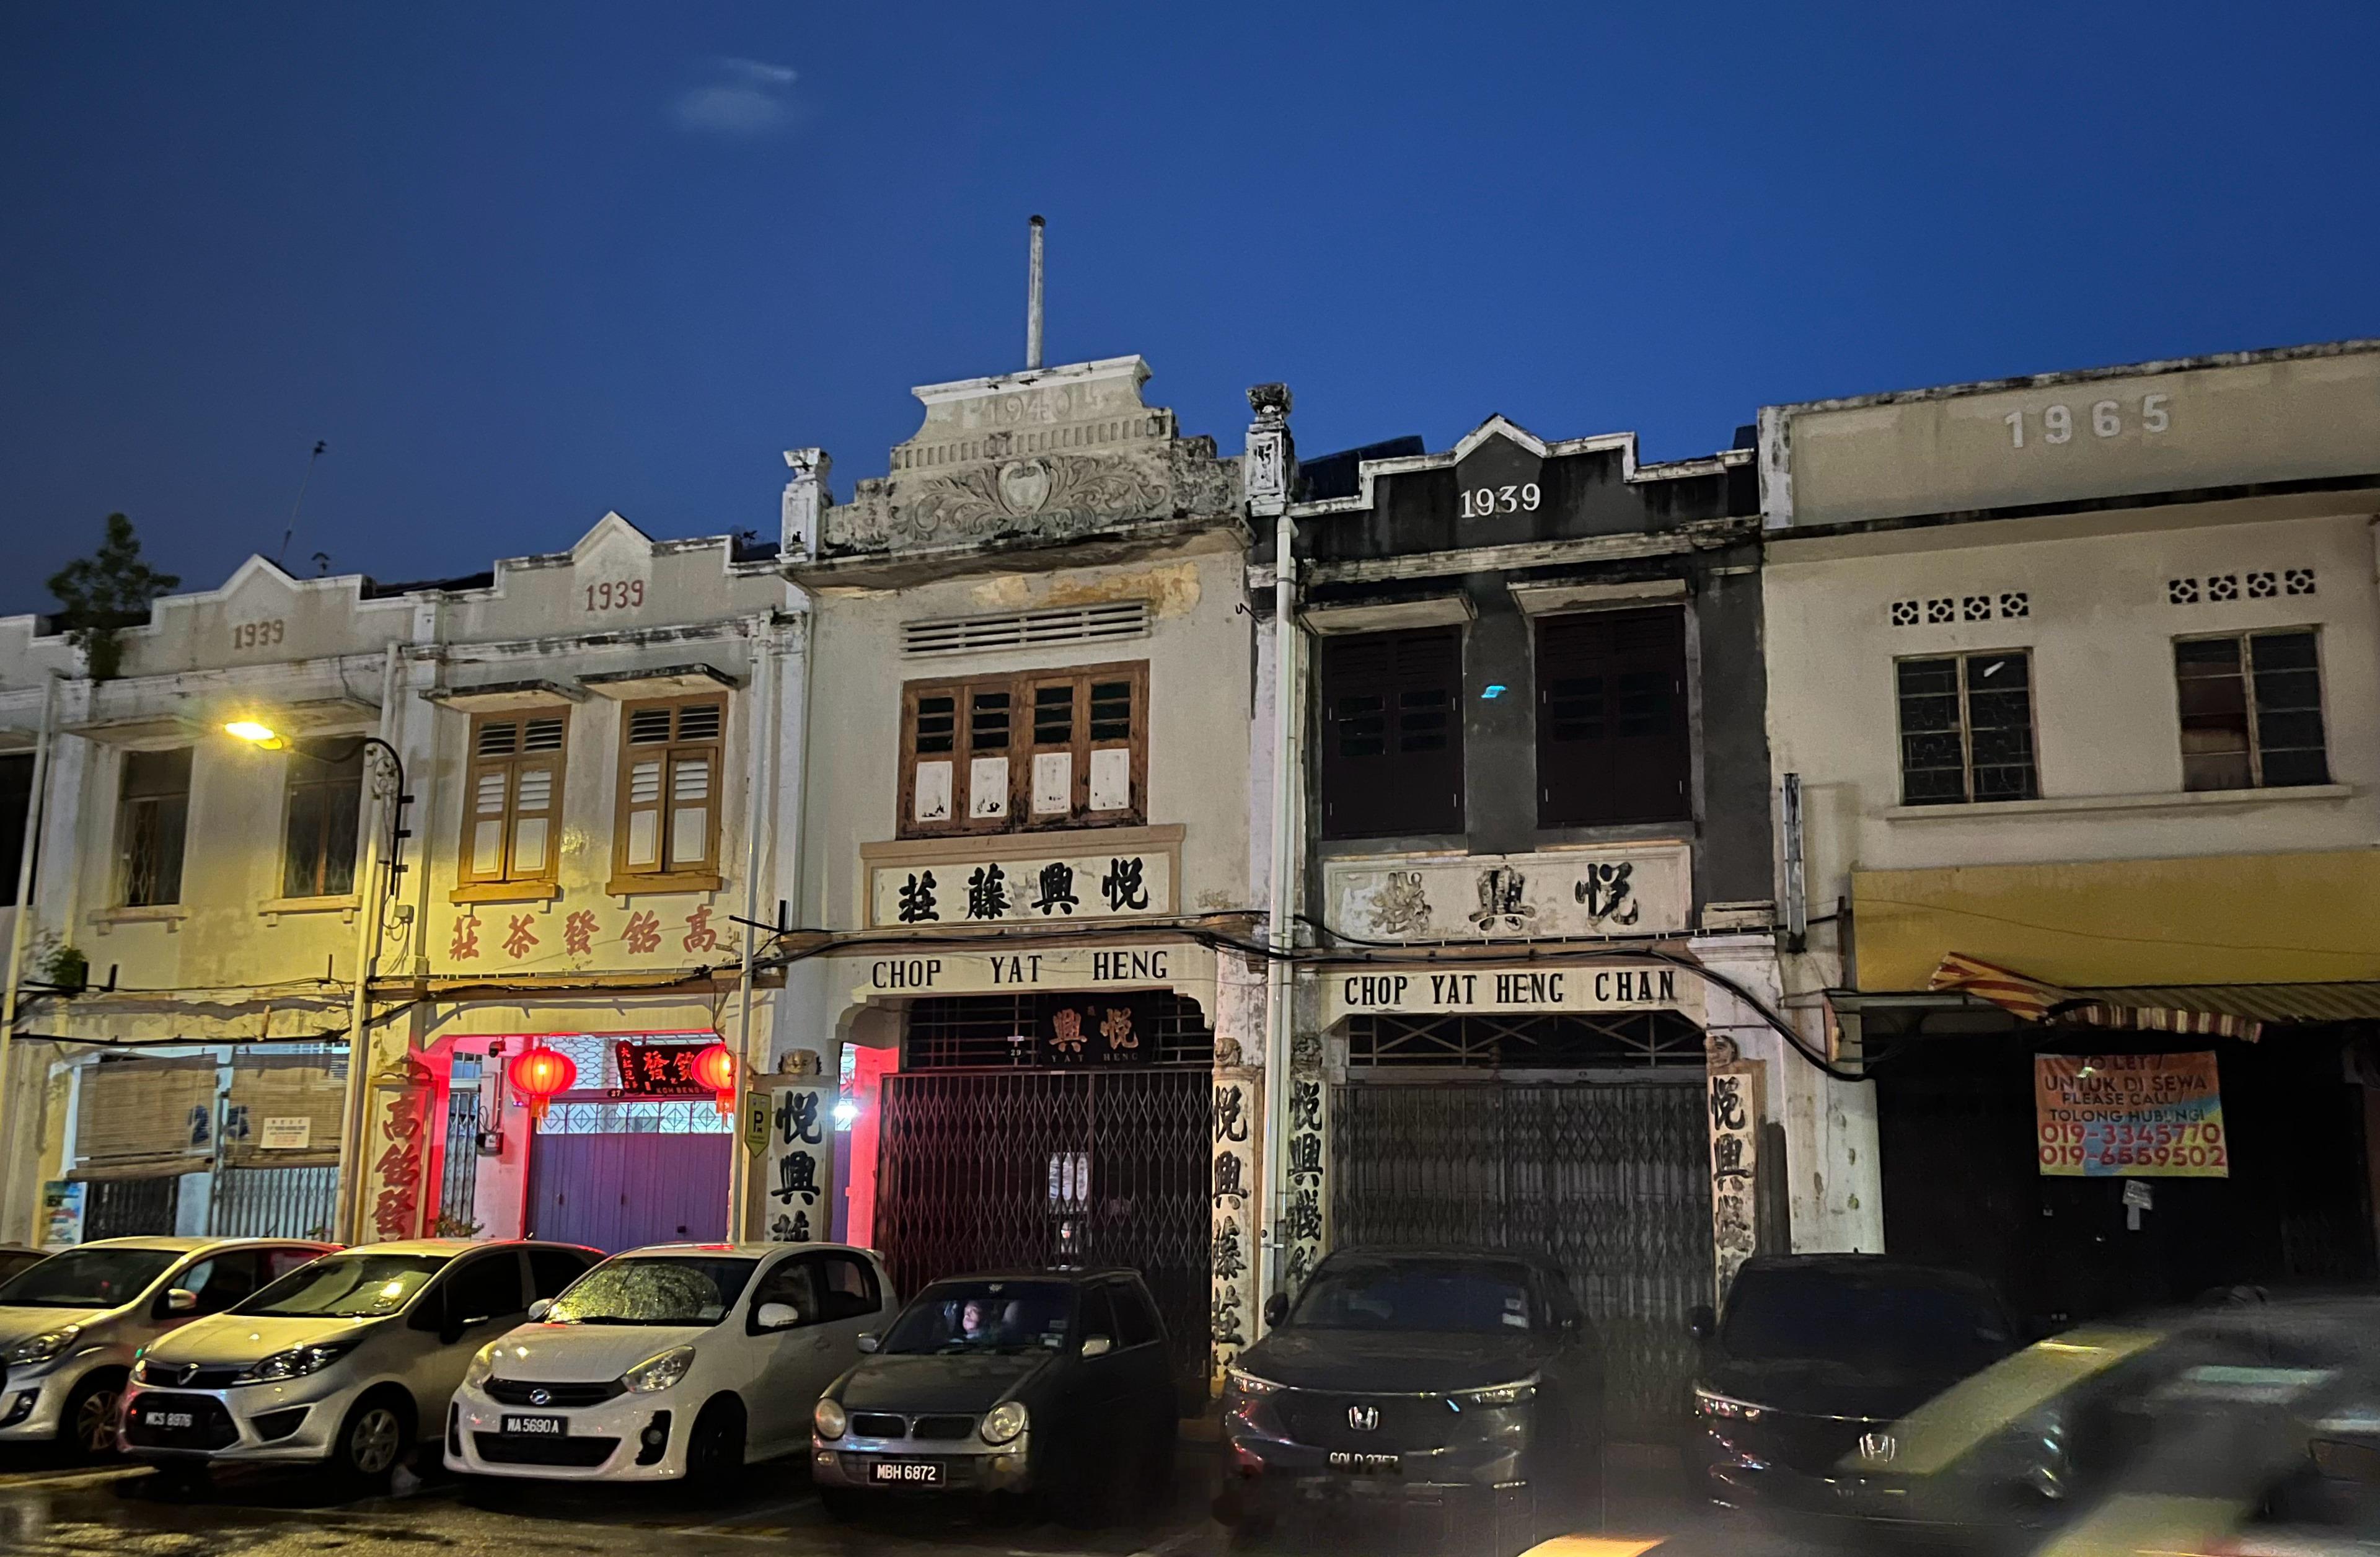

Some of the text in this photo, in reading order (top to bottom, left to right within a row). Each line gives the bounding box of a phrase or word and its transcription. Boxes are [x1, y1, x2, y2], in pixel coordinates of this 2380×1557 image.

[2004, 394, 2168, 448] 1965
[1460, 483, 1540, 518] 1939
[586, 580, 644, 612] 1939
[234, 619, 284, 650] 1939
[873, 950, 1168, 989] CHOP YAT HENG
[1344, 970, 1675, 1005] CHOP YAT HENG CHAN
[1051, 1053, 1138, 1063] YAT HENG
[2081, 1055, 2106, 1070] TO
[2113, 1055, 2149, 1070] LET
[2045, 1075, 2208, 1093] UNTUK DI SEWA
[2062, 1092, 2124, 1106] PLEASE
[2130, 1092, 2174, 1105] CALL
[753, 1110, 764, 1133] P
[2050, 1108, 2123, 1123] TOLONG
[2040, 1123, 2221, 1145] 019-3345770
[507, 1418, 559, 1434] WA 5690 A
[877, 1464, 937, 1481] MBH 6872
